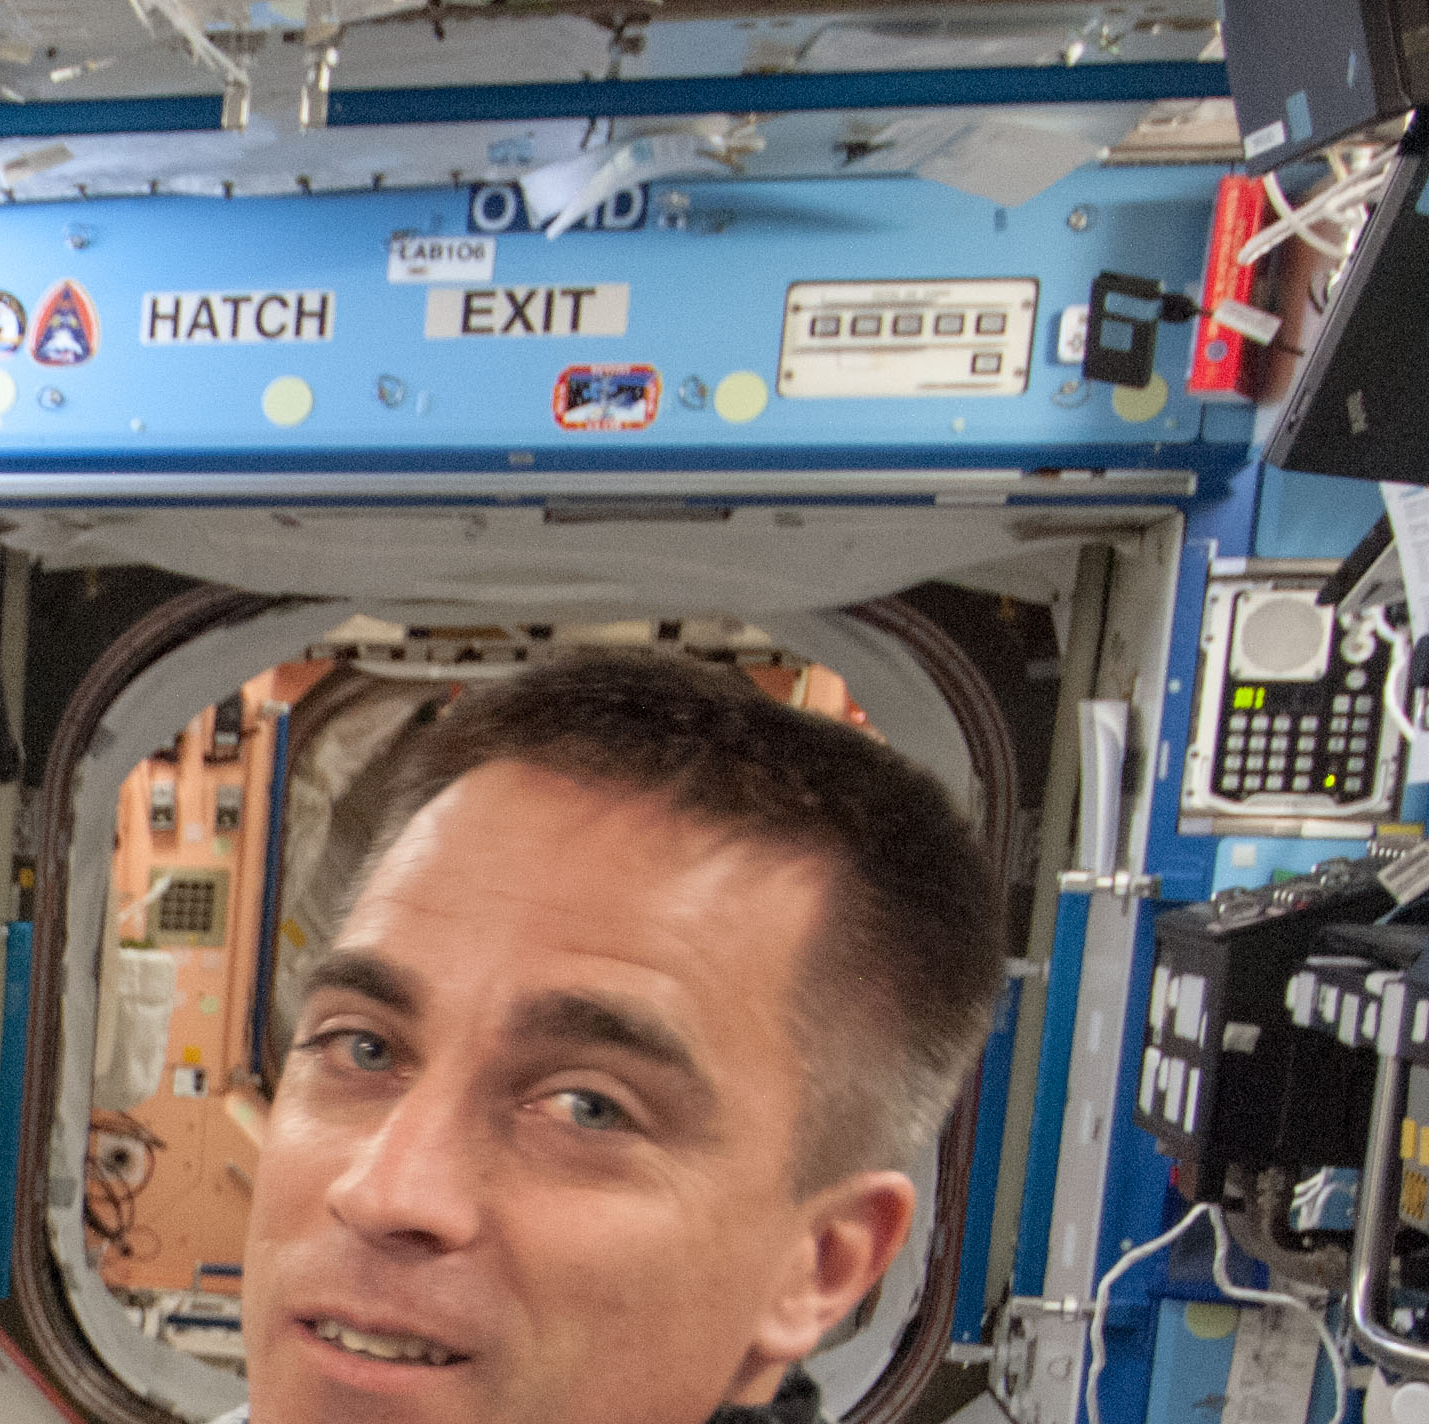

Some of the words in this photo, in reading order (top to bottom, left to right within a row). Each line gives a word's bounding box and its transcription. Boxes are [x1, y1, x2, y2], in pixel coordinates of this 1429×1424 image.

[471, 183, 647, 232] OD
[148, 293, 330, 342] HATCH
[461, 288, 597, 335] EXIT
